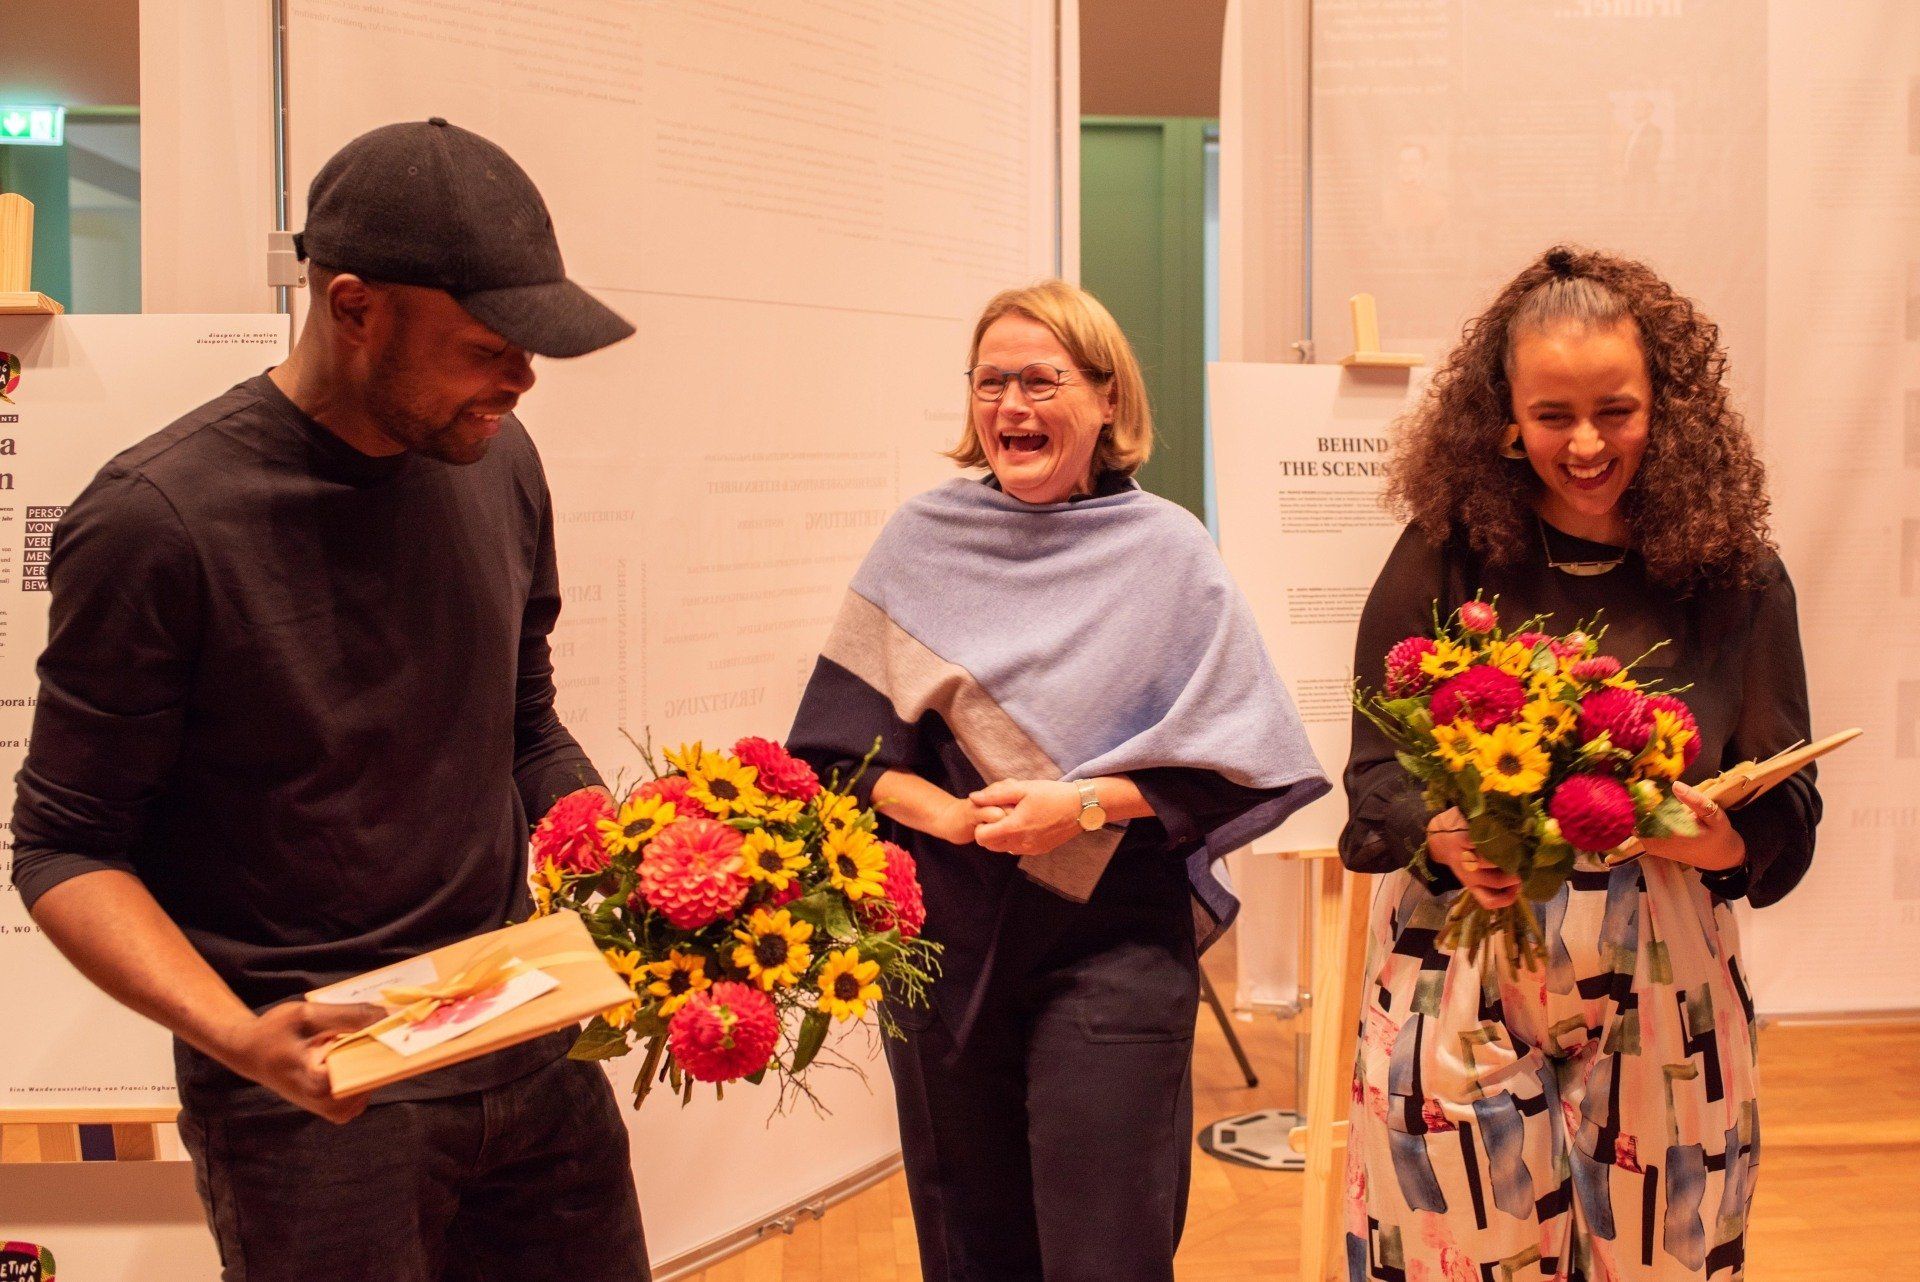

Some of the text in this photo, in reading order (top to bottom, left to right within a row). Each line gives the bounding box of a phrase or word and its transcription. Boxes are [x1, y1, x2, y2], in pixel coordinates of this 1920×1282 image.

[1317, 437, 1388, 453] BEHIND
[1279, 461, 1390, 477] THE SCENES
[28, 507, 67, 518] PERSÖ
[28, 523, 53, 532] VON
[25, 566, 46, 576] VER
